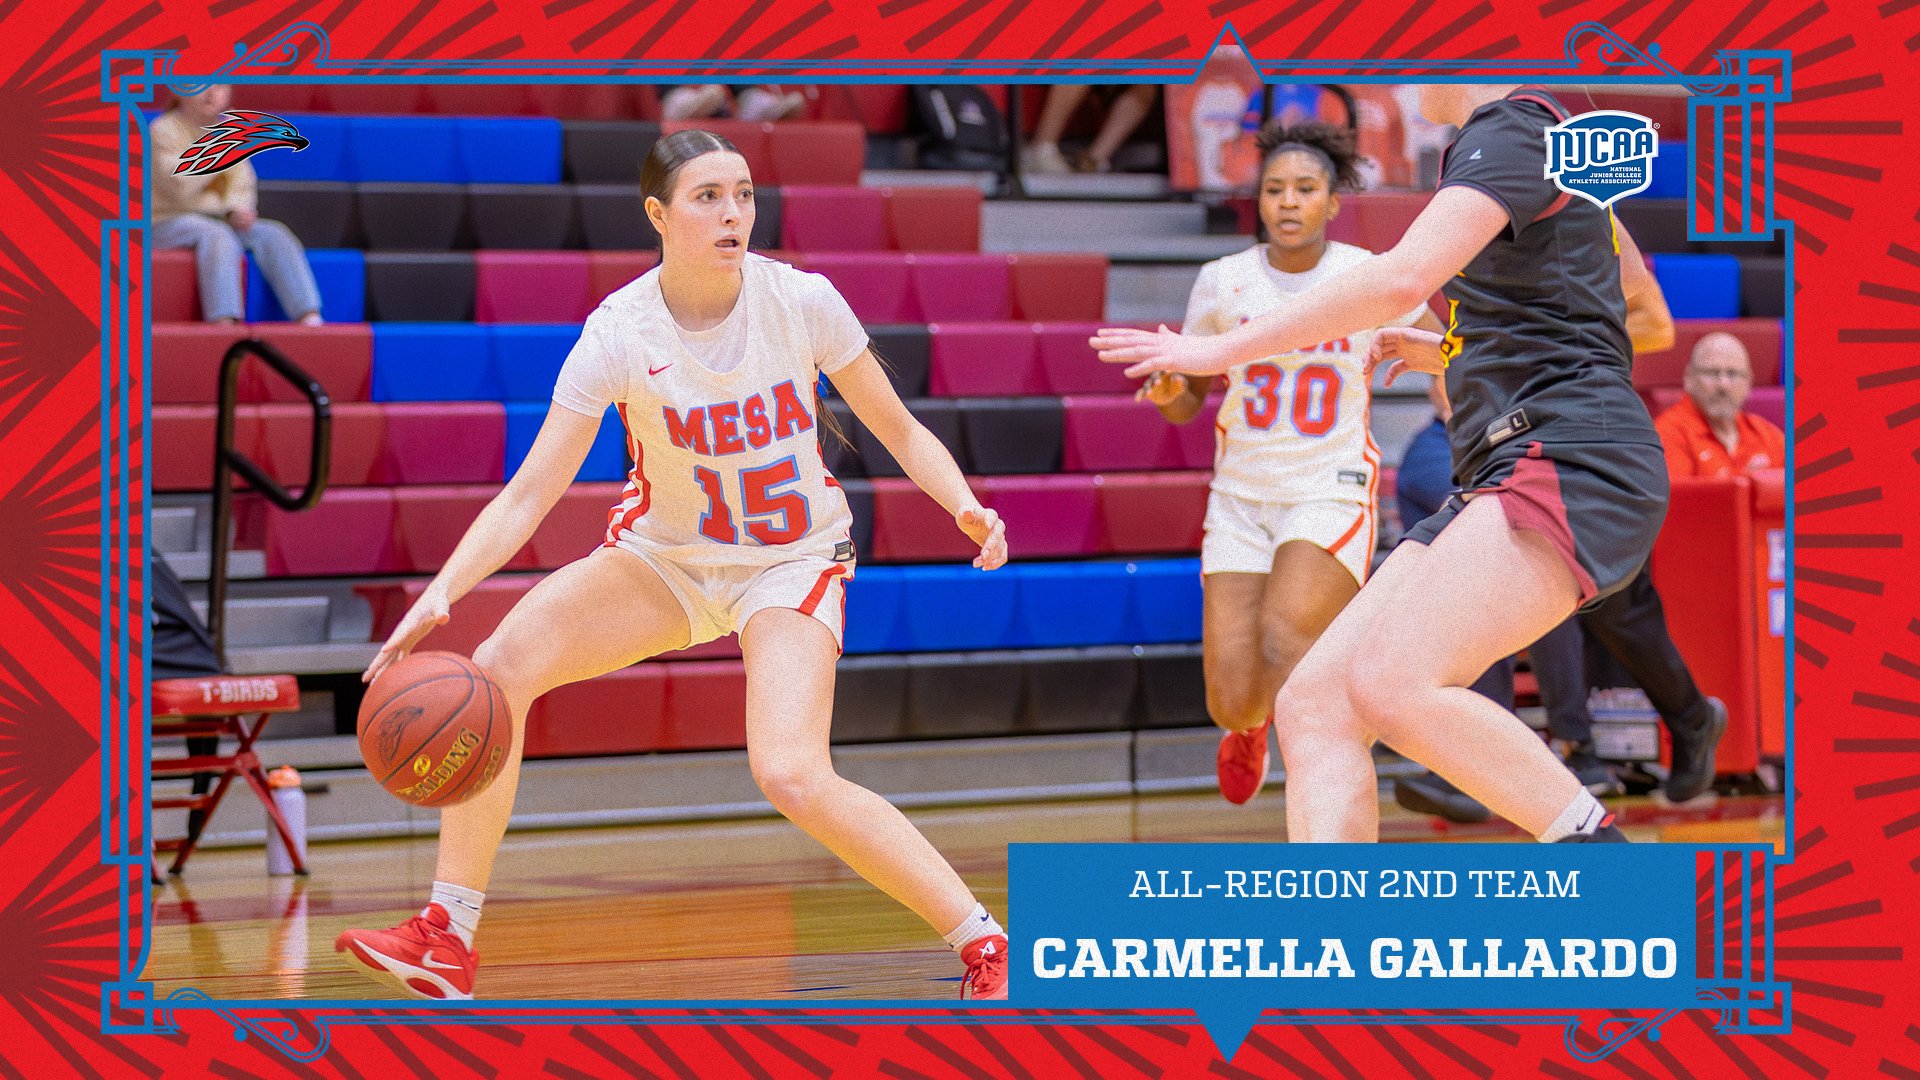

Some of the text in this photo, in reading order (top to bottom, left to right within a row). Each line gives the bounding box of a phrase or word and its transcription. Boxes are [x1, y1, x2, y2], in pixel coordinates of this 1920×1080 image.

[662, 379, 814, 457] MESA
[1242, 361, 1344, 438] 30
[693, 454, 813, 546] 15
